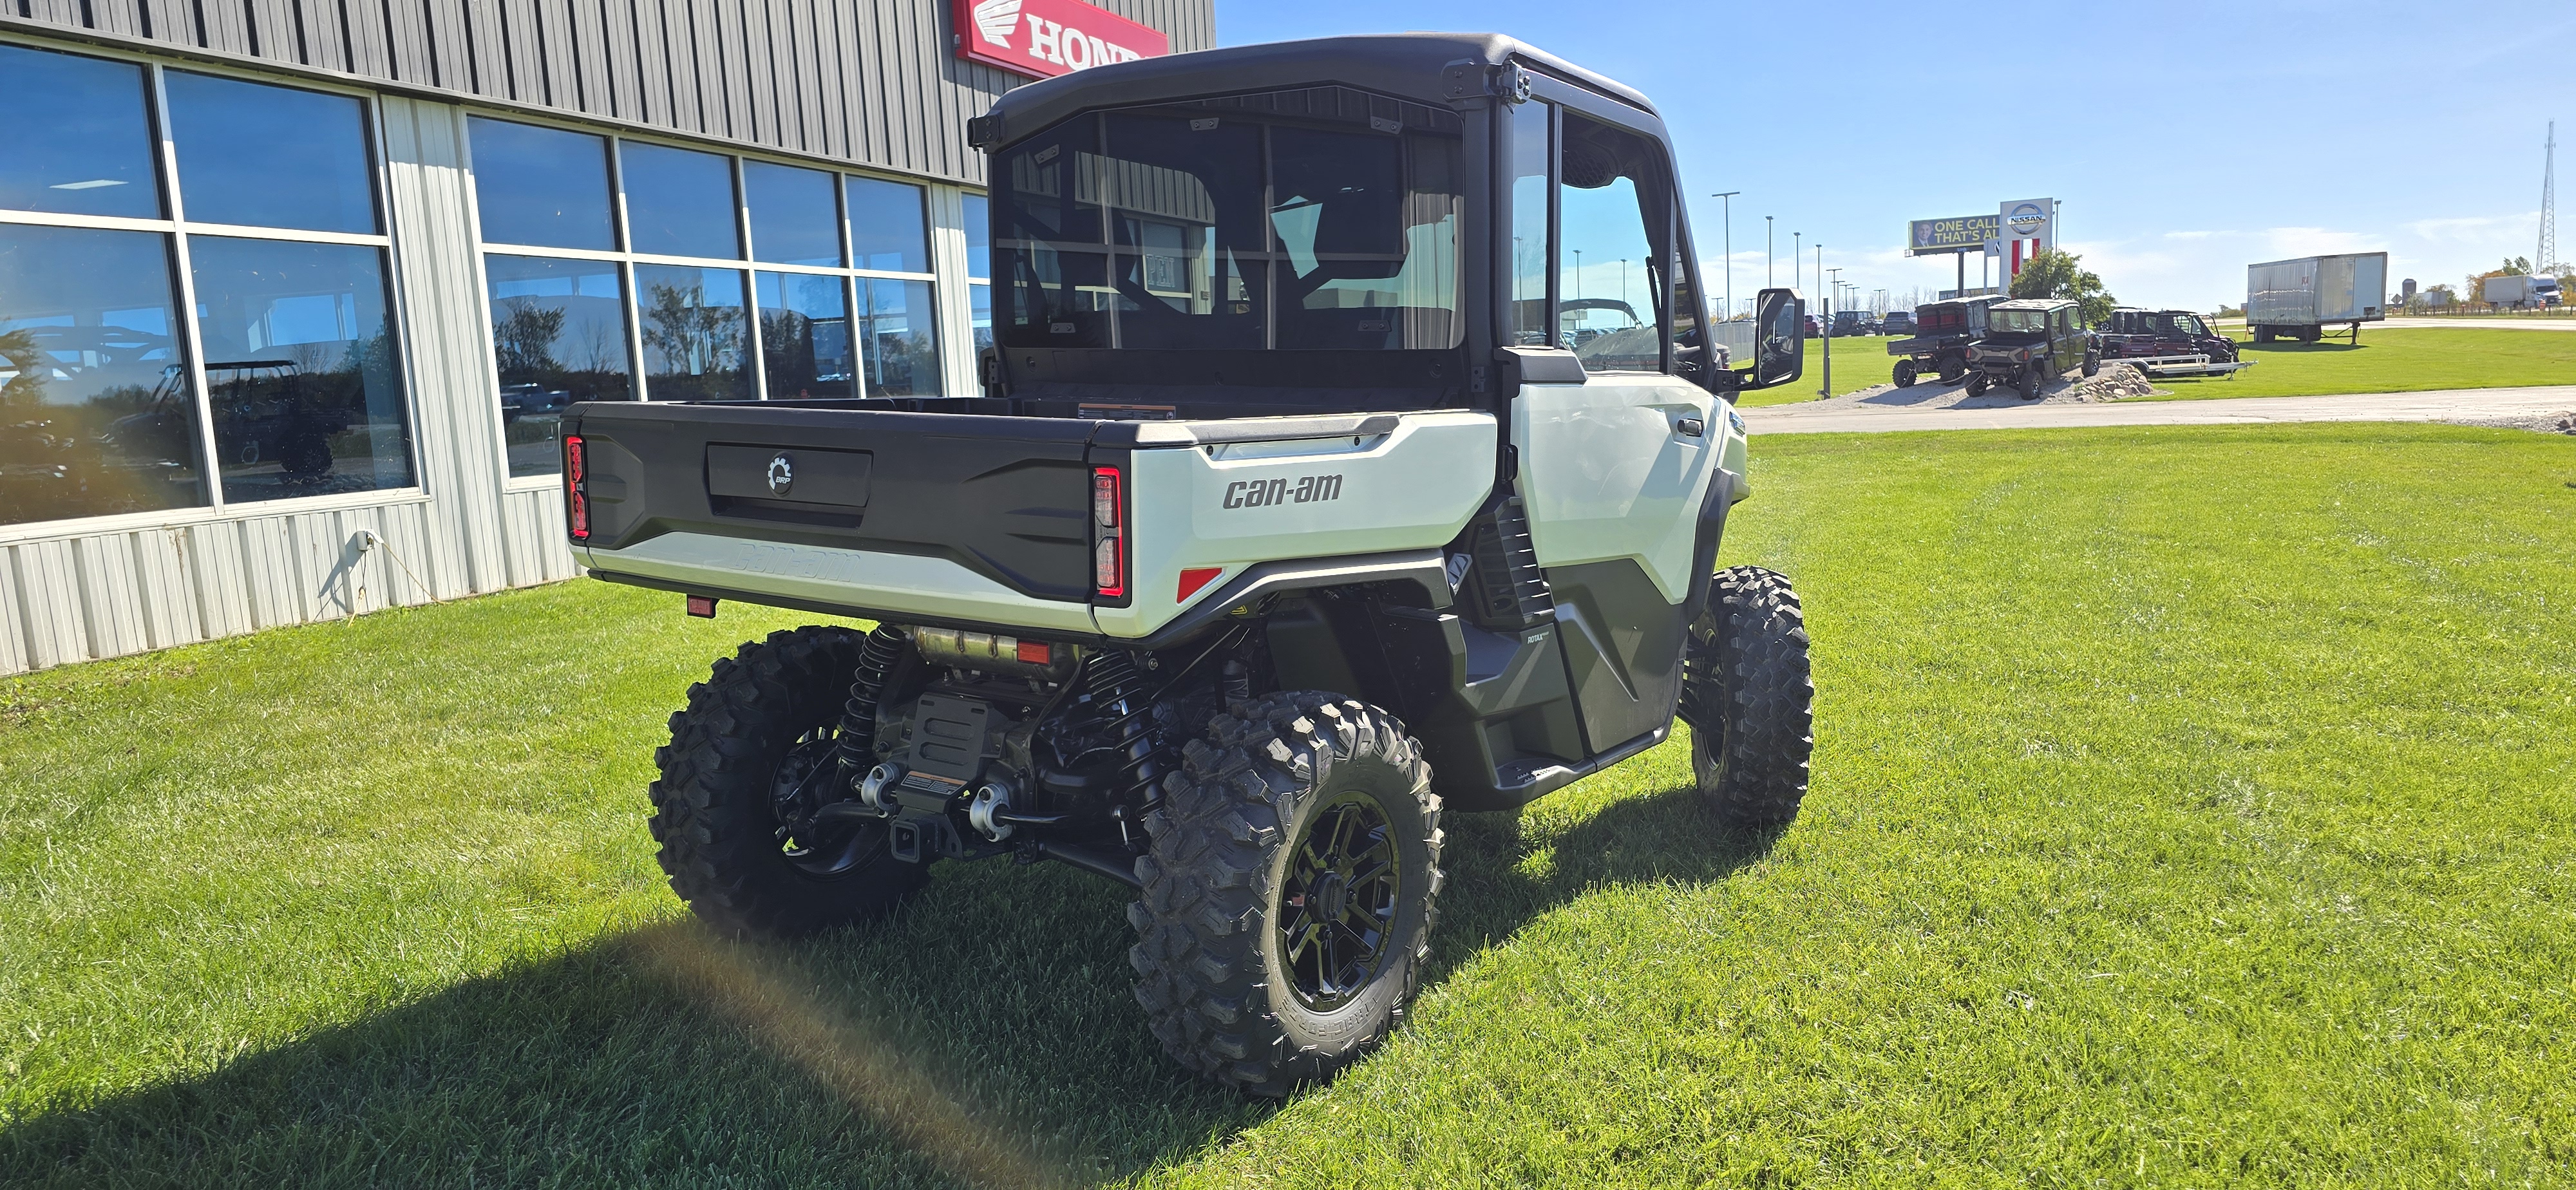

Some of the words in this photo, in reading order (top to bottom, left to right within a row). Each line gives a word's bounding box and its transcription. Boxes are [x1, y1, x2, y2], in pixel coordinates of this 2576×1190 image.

[1935, 220, 1964, 232] ONE
[1967, 218, 2000, 230] CALL
[2011, 215, 2042, 224] NISSAN
[1934, 230, 1980, 243] THAT'S
[775, 476, 791, 484] BRP
[1222, 474, 1343, 509] can-am
[729, 543, 861, 583] can-am
[1527, 633, 1543, 644] ROTAX
